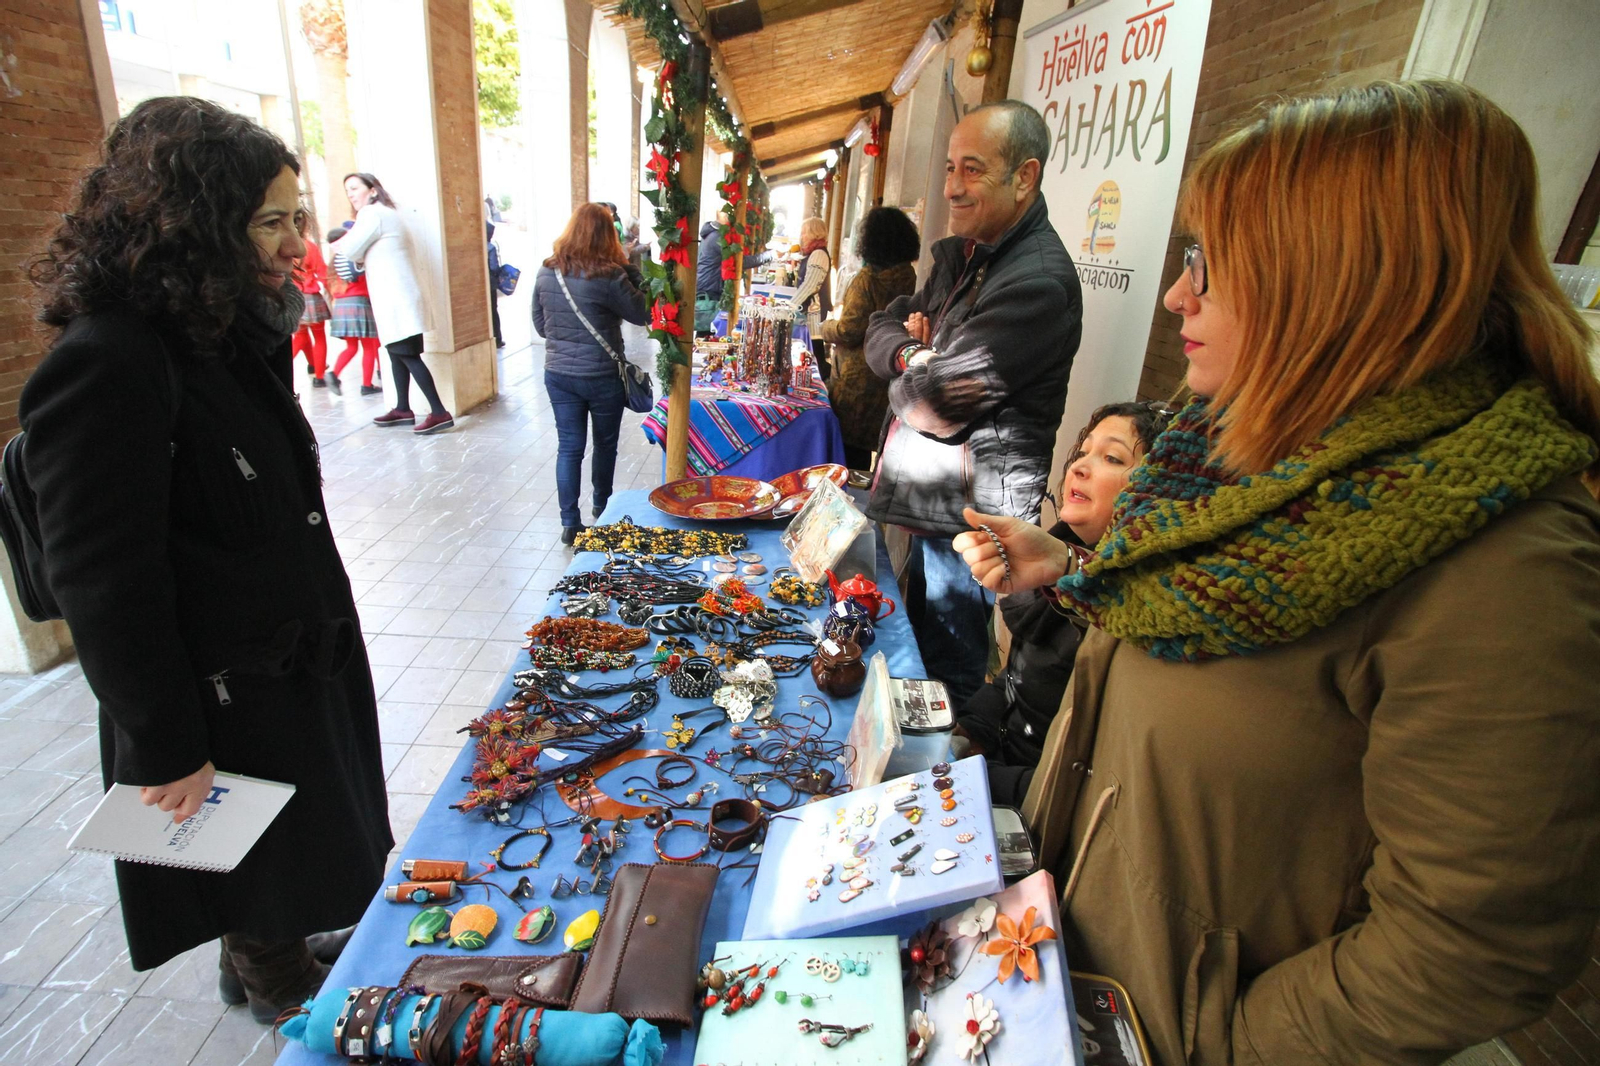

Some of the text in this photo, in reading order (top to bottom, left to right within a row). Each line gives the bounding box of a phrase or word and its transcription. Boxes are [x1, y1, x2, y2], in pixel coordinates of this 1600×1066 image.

[1038, 12, 1168, 99] Huelva con
[204, 786, 231, 805] H
[166, 816, 196, 846] HUELVA
[174, 806, 216, 852] DIPUTACIÓN
